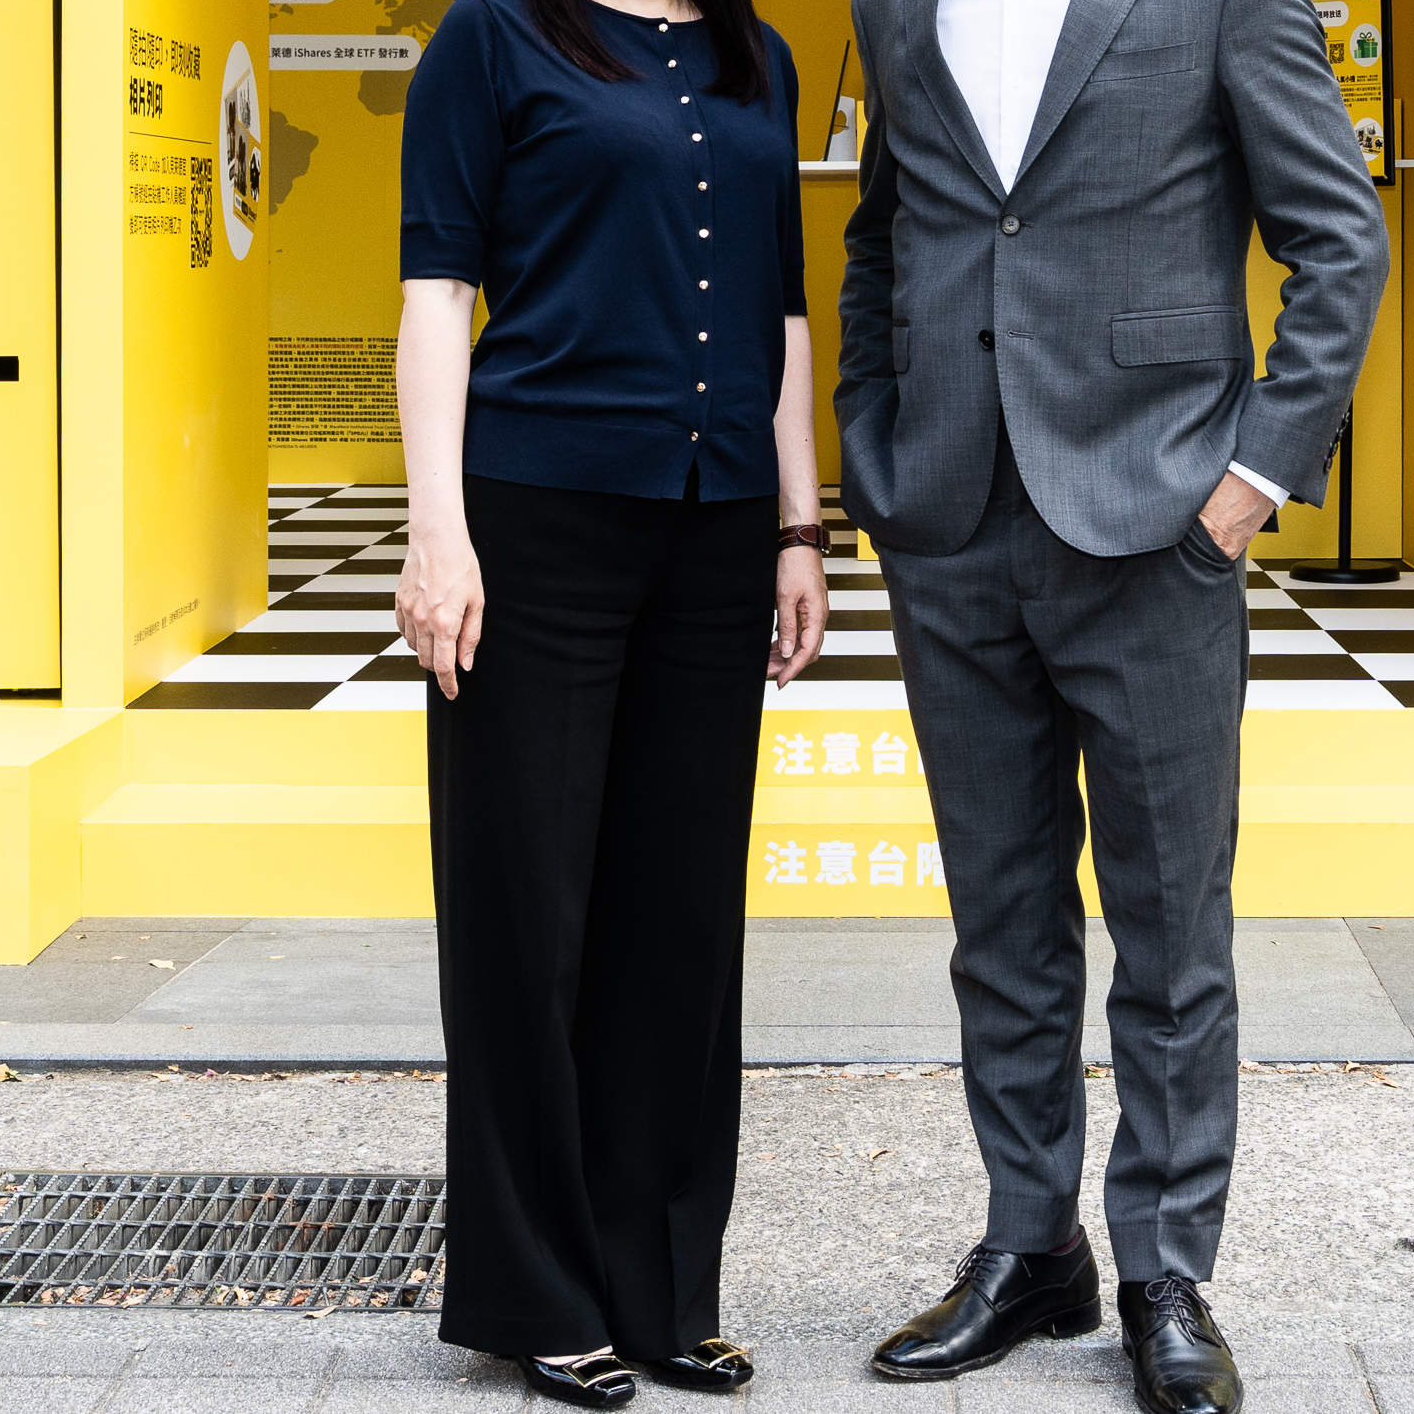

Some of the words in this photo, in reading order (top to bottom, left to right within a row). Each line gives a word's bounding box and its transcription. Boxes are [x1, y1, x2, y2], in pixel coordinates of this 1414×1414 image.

[269, 47, 292, 59] 萊德
[294, 47, 332, 59] iShares
[333, 47, 355, 59] 全球
[357, 48, 376, 58] ETF
[378, 47, 409, 59] 發行數
[129, 75, 164, 120] 相片列印
[772, 730, 925, 776] 注意台
